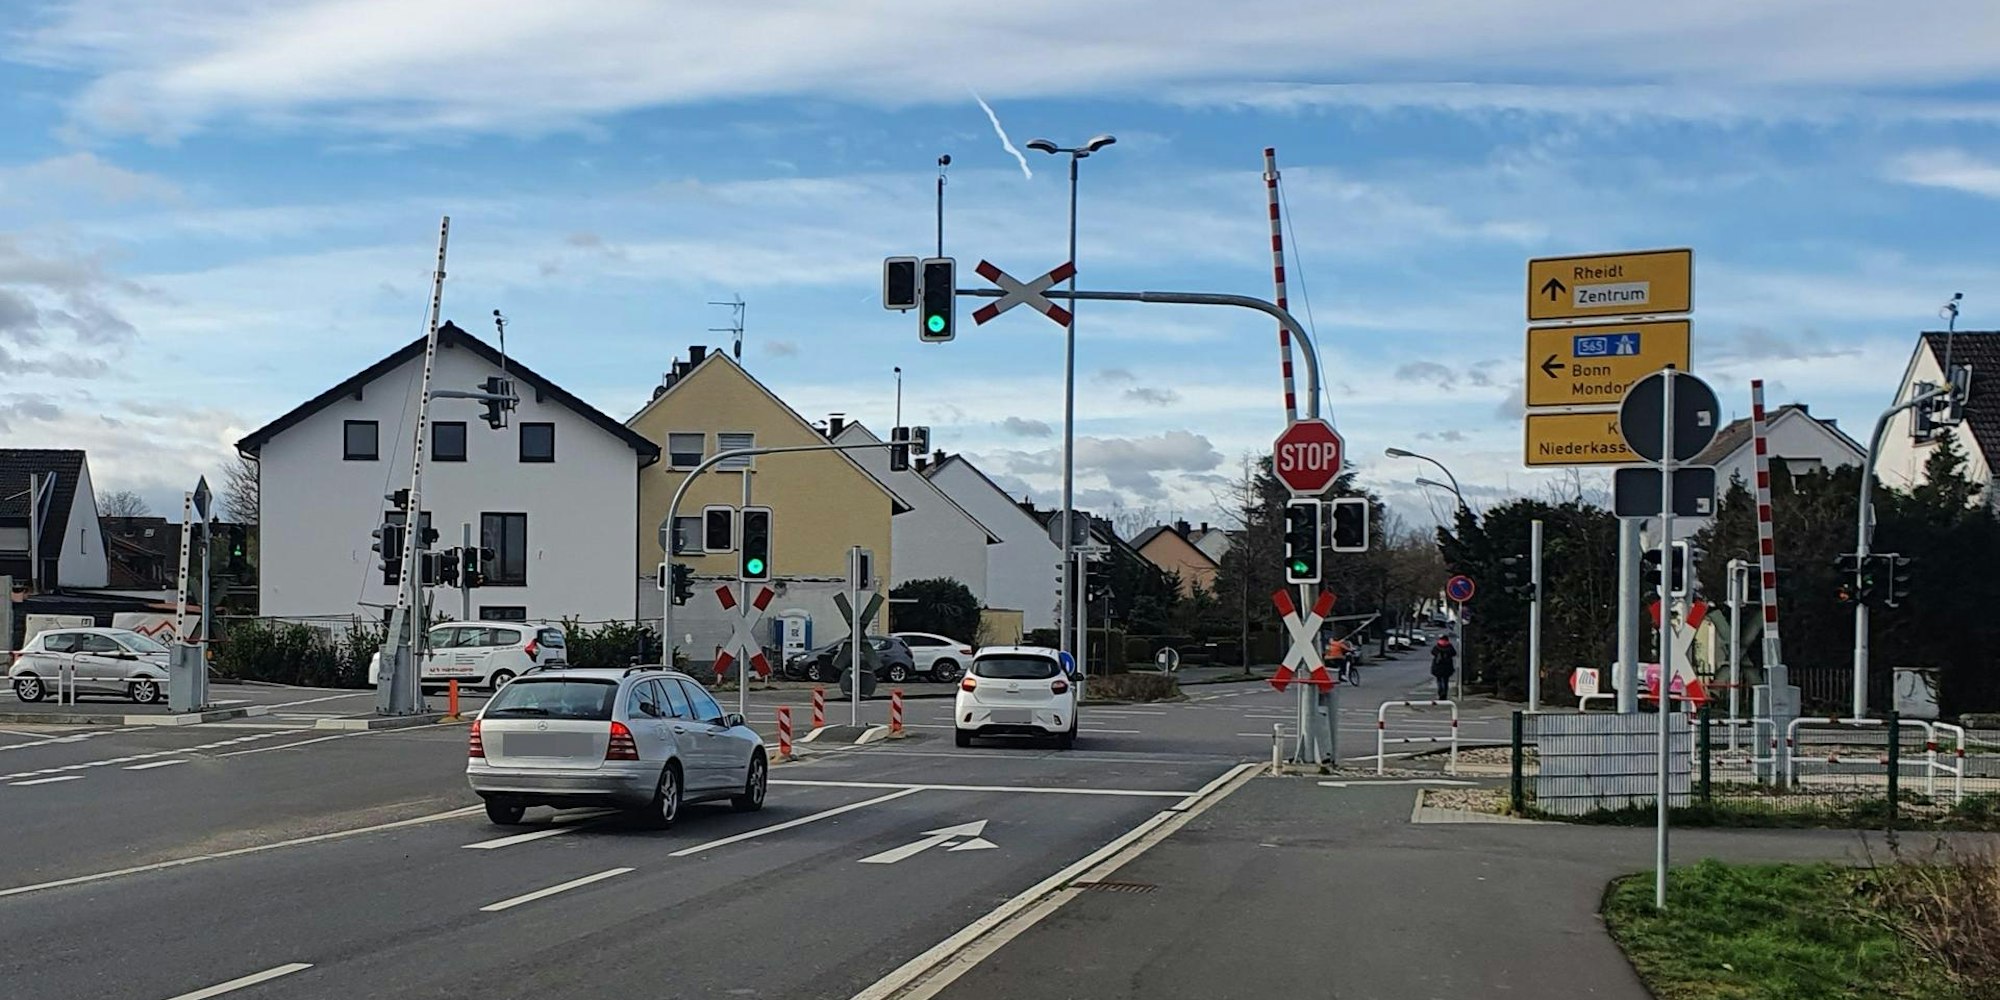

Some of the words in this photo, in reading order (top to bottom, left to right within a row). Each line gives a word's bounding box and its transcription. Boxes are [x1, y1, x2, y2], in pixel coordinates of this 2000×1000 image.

[1573, 265, 1623, 280] Rheidt
[1578, 288, 1645, 303] Zentrum
[1572, 364, 1611, 377] Bonn
[1572, 381, 1634, 395] Mondor
[1539, 442, 1632, 455] Niederkass
[1280, 442, 1337, 471] STOP
